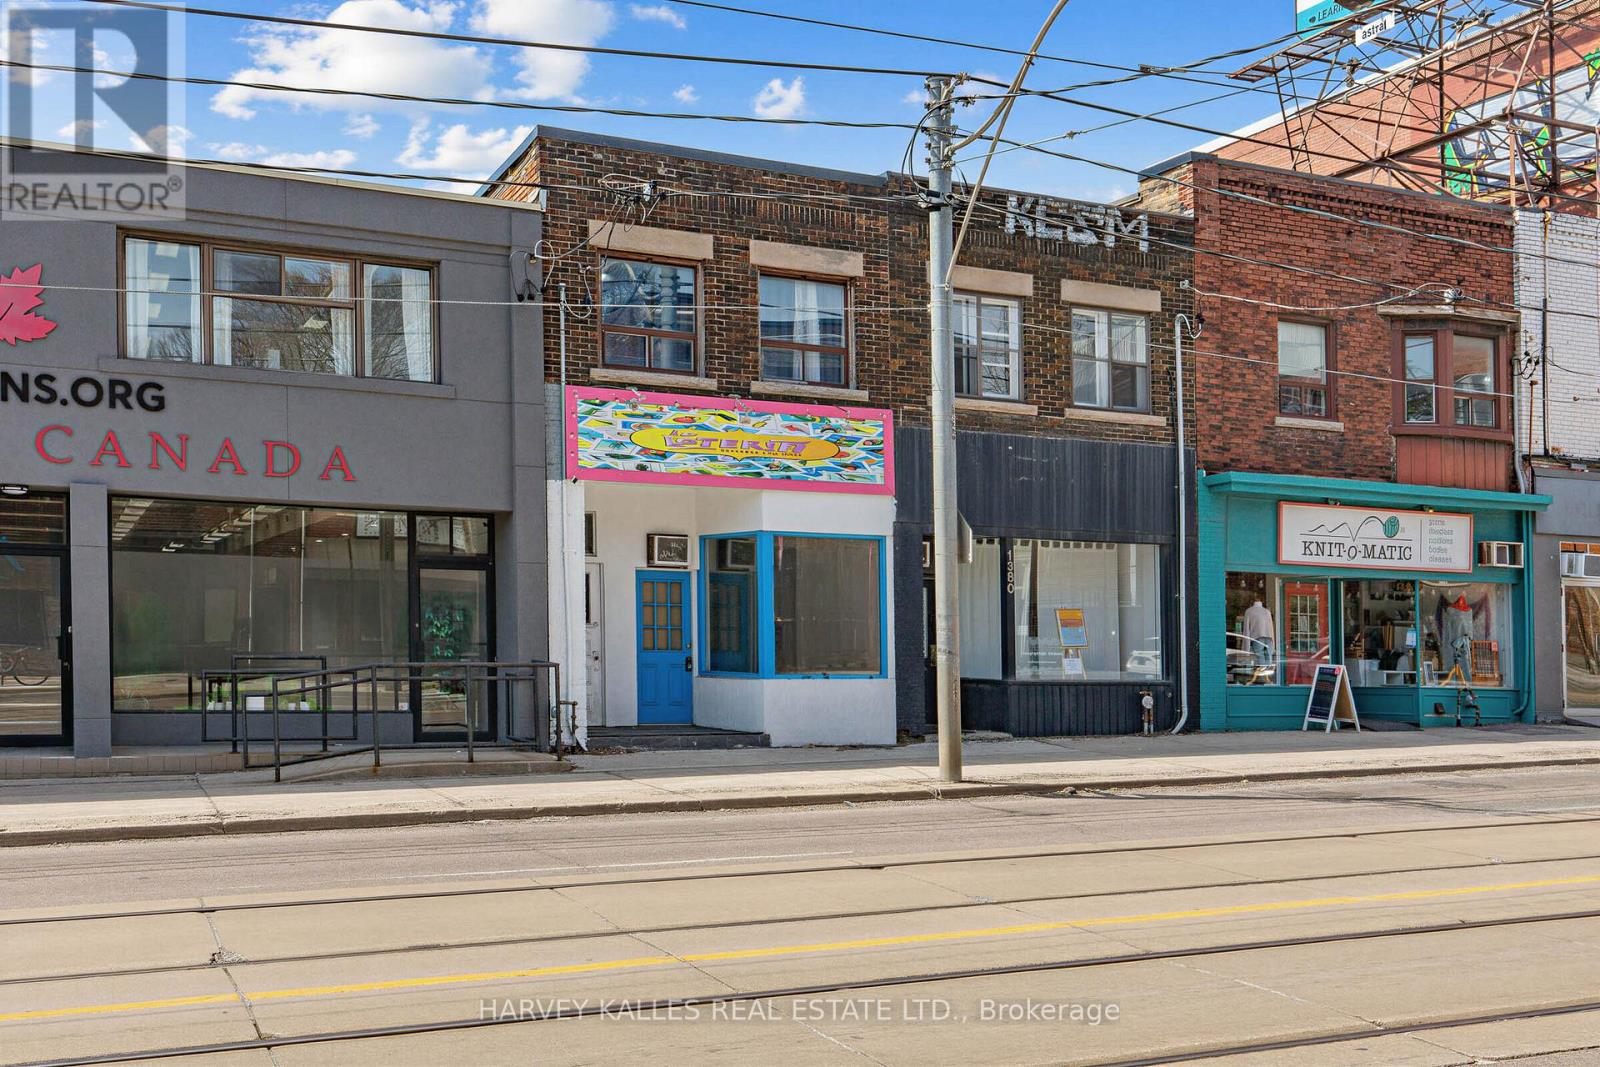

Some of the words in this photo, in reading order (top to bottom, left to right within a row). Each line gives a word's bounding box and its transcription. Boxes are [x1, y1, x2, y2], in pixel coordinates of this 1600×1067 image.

[1361, 18, 1388, 40] astral
[1, 371, 166, 412] NS.ORG
[35, 425, 357, 481] CANADA
[1007, 549, 1015, 594] 1380
